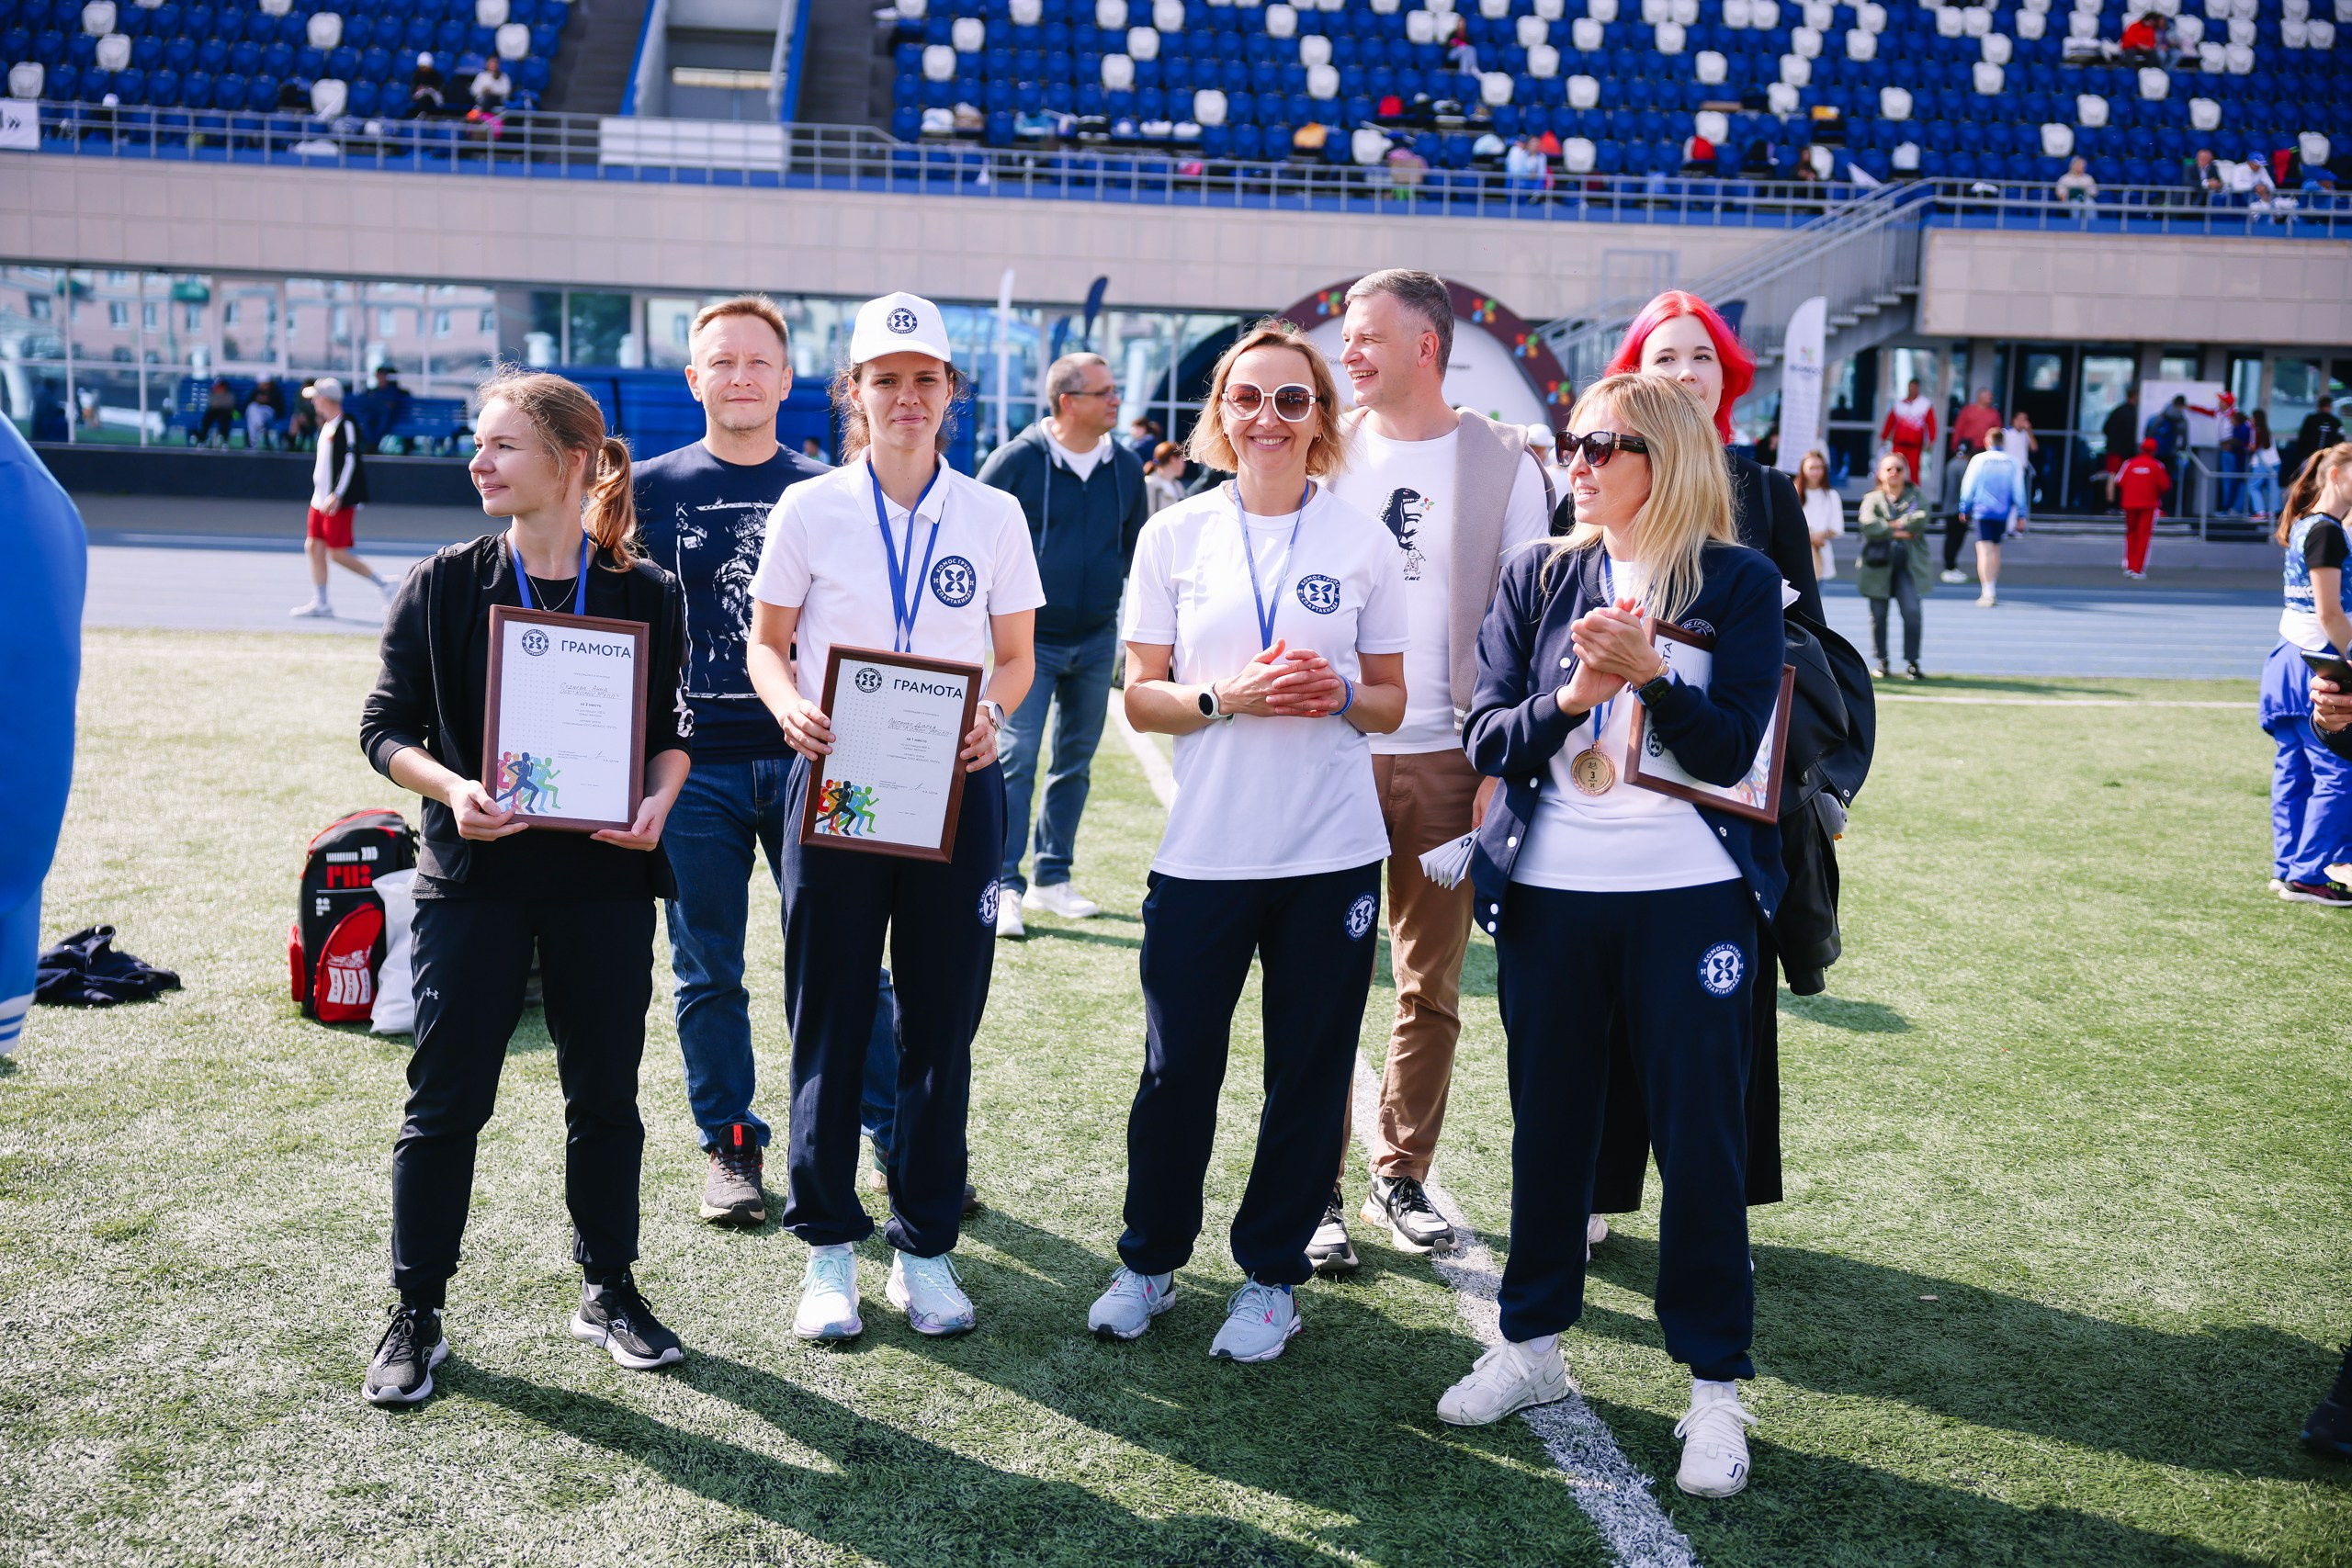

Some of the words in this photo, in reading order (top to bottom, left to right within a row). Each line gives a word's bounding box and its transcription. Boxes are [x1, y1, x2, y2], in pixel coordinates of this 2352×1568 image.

[936, 558, 956, 573] КОМОС
[957, 559, 973, 575] ГРУПП
[1300, 575, 1322, 586] КОМОС
[1322, 576, 1340, 589] ГРУПП
[936, 588, 973, 604] СПАРТАКИАДА
[1301, 597, 1339, 614] СПАРТАКИАДА
[1694, 620, 1713, 633] ГРУПП
[561, 639, 631, 659] ГРАМОТА
[893, 679, 963, 699] ГРАМОТА
[1590, 771, 1595, 779] 3
[1349, 896, 1364, 916] КОМОС
[1702, 943, 1725, 964] КОМОС
[1726, 943, 1742, 959] ГРУПП
[1703, 974, 1742, 995] СПАРТАКИАДА
